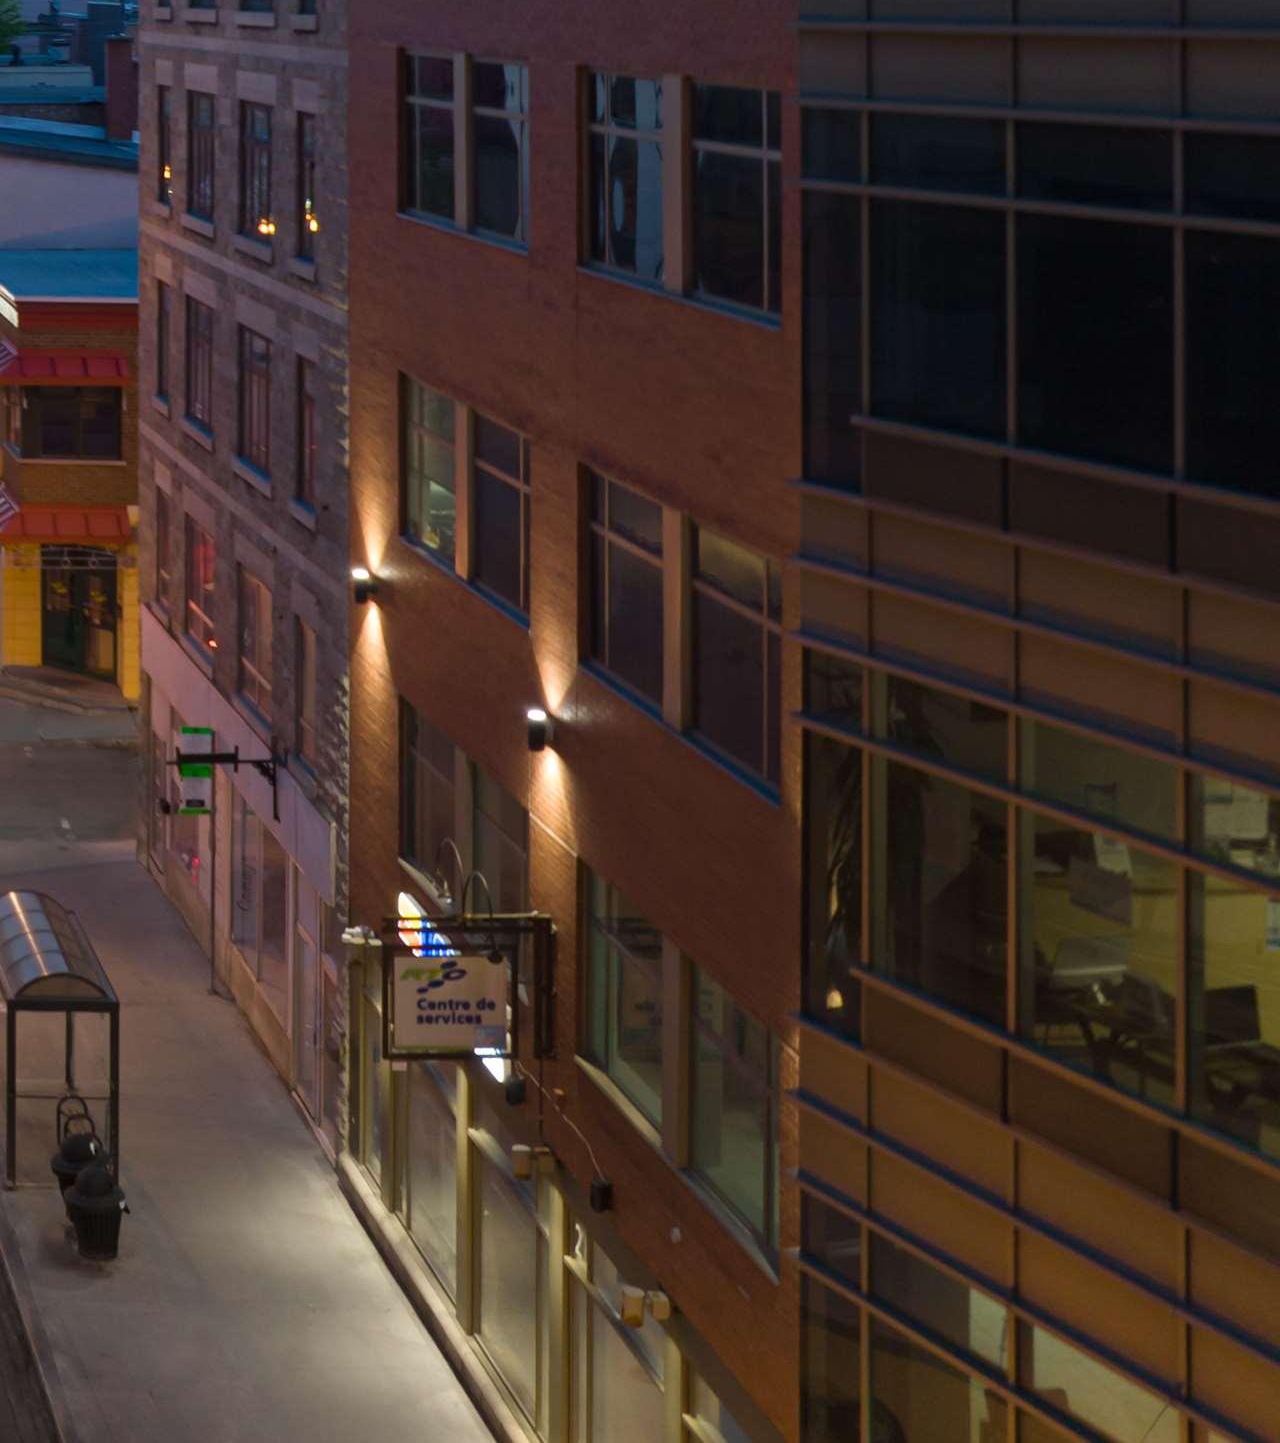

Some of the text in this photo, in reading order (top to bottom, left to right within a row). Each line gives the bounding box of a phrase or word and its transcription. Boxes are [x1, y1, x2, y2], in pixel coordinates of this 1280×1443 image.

[416, 997, 497, 1011] Centre de
[416, 1011, 482, 1025] services
